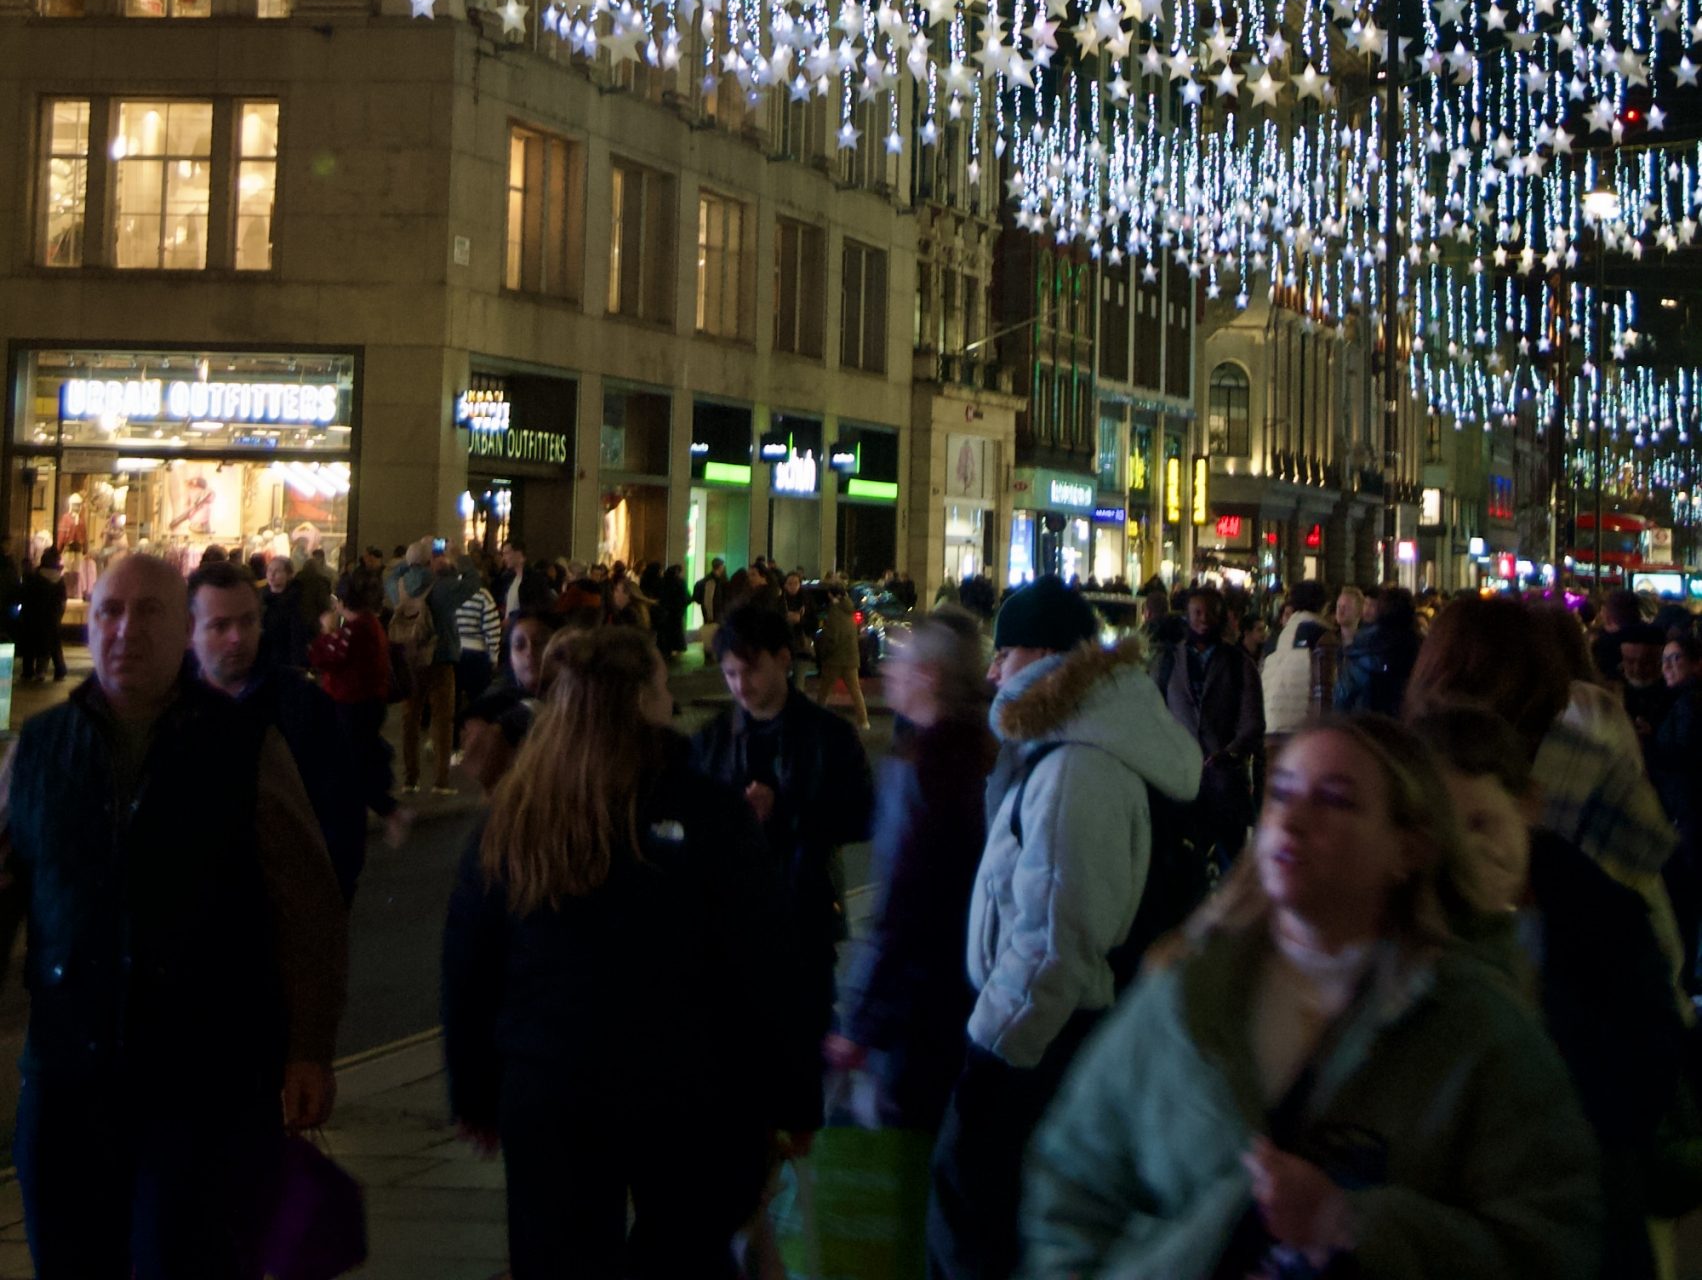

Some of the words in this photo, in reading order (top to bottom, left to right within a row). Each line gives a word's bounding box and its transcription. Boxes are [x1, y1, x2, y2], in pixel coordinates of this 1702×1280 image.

[67, 379, 162, 416] URBAN
[168, 381, 337, 421] OUTFITTERS
[507, 428, 567, 463] OUTFITTERS
